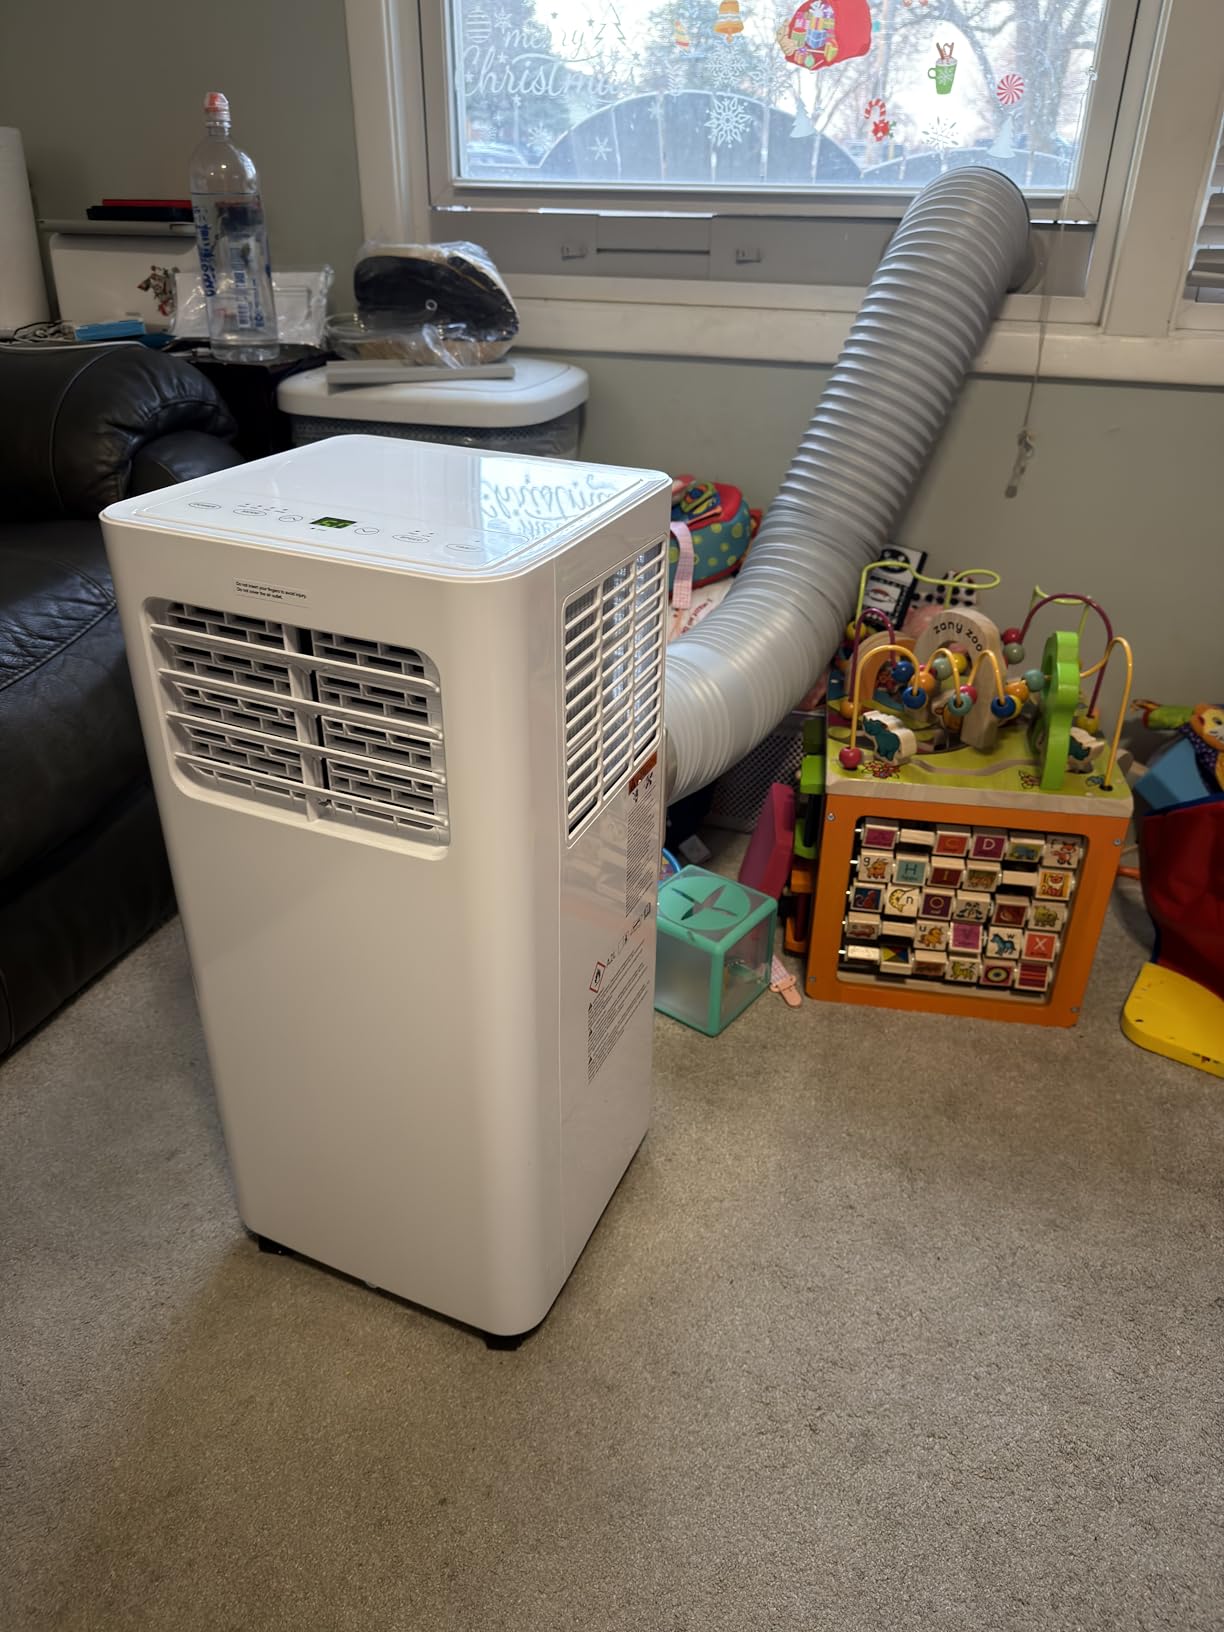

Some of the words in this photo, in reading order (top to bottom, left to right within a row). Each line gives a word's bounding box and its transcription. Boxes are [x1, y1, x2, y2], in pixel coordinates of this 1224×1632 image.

[933, 621, 963, 634] zany
[965, 628, 983, 652] zoo
[982, 838, 996, 851] D
[904, 863, 918, 876] H
[905, 896, 914, 905] n
[1032, 936, 1048, 951] X
